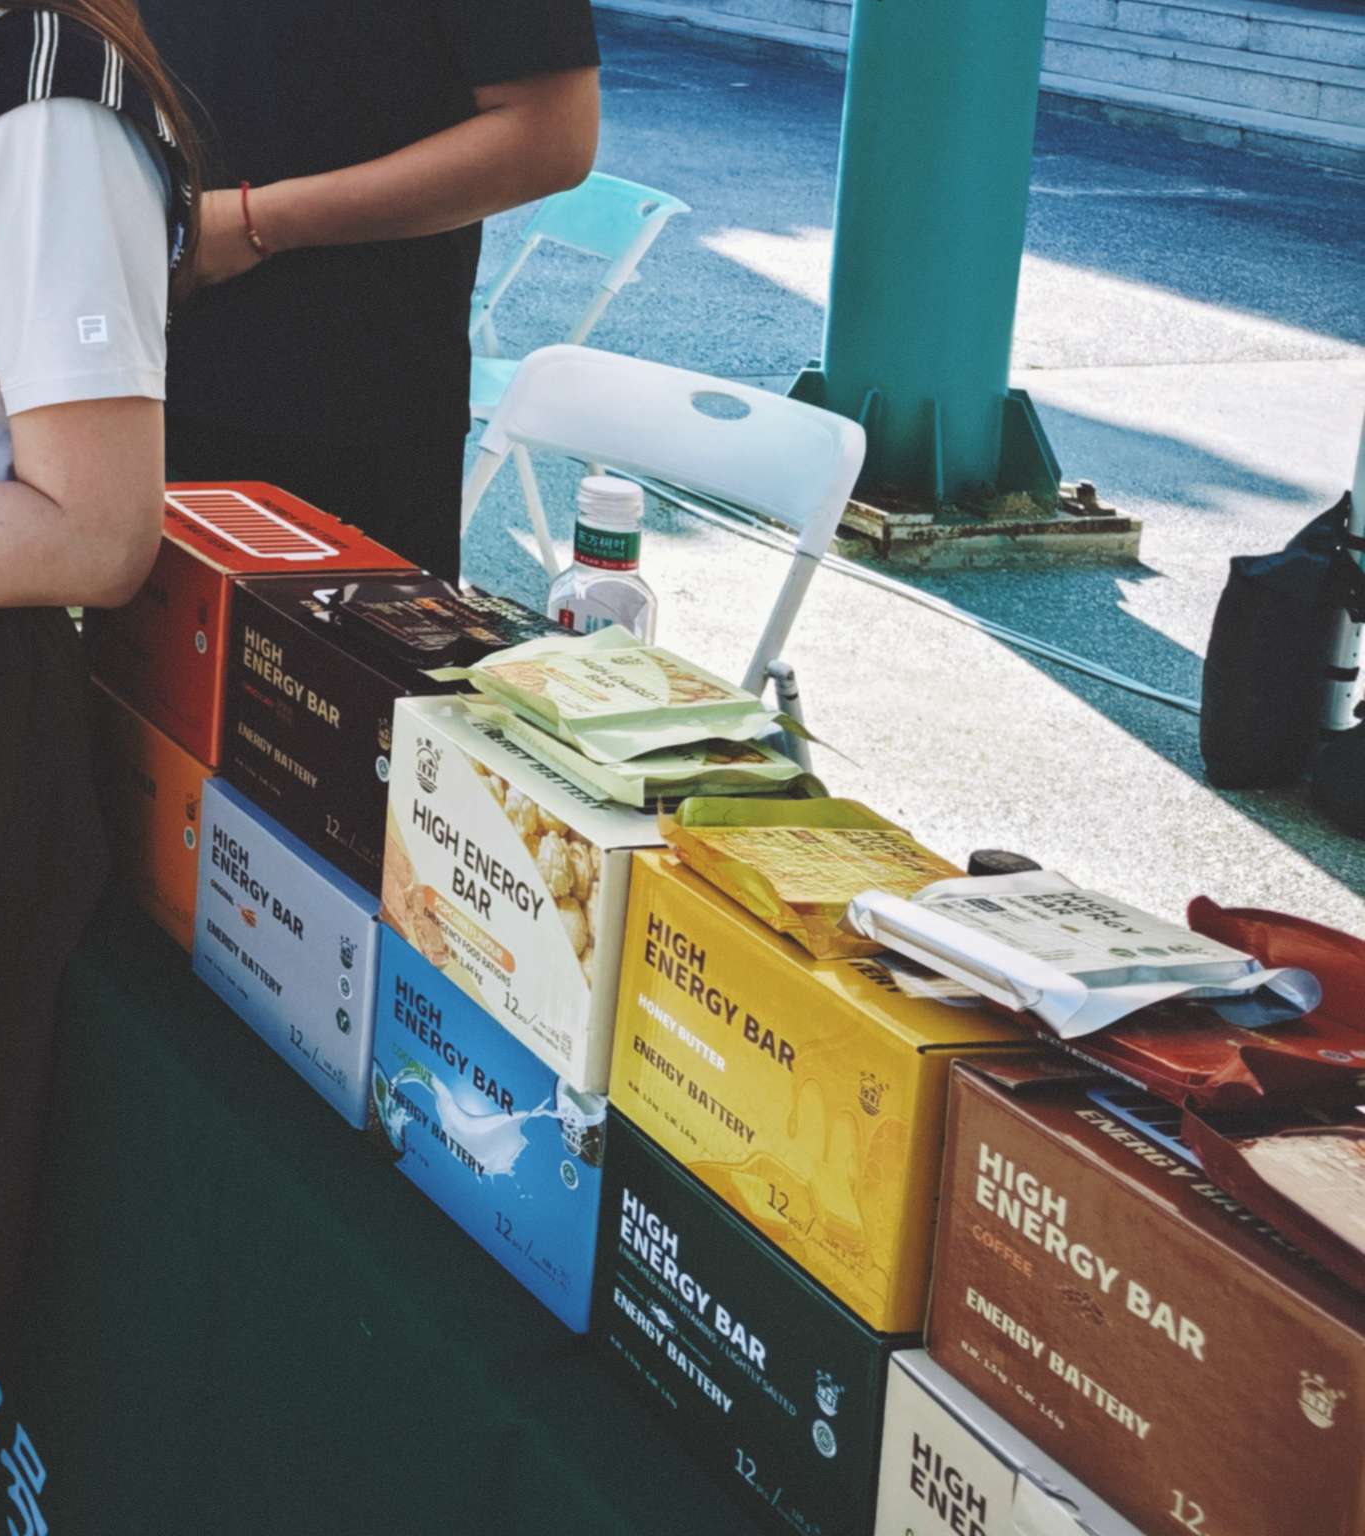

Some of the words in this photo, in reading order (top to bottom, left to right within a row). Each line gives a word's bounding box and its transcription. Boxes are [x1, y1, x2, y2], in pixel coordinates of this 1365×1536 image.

[244, 625, 284, 667] HIGH
[243, 647, 306, 703] ENERGY
[306, 689, 342, 730] BAR
[237, 720, 272, 756] ENERGY
[273, 747, 319, 789] BATTERY
[528, 762, 610, 812] BATTERY
[212, 823, 251, 871] HIGH
[324, 813, 341, 842] 12
[412, 798, 461, 857] HIGH
[462, 838, 545, 922] ENERGY
[210, 844, 271, 909] ENERGY
[272, 894, 305, 942] BAR
[451, 866, 493, 921] BAR
[1041, 893, 1142, 935] ENERGY
[1060, 891, 1128, 919] HIGH
[206, 917, 241, 959] ENERGY
[240, 948, 284, 999] BATTERY
[461, 941, 482, 965] FOOD
[646, 912, 707, 974] HIGH
[395, 975, 442, 1029] HIGH
[503, 991, 519, 1017] 12
[637, 992, 678, 1034] HONEY
[677, 1023, 727, 1073] BUTTER
[644, 941, 740, 1026] ENERGY
[743, 1012, 796, 1073] BAR
[288, 1022, 304, 1052] 12
[394, 999, 469, 1076] ENERGY
[471, 1065, 515, 1117] BAR
[633, 1034, 687, 1089] ENERGY
[687, 1078, 757, 1145] BATTERY
[387, 1083, 429, 1129] ENERGY
[430, 1119, 486, 1177] BATTERY
[1075, 1109, 1198, 1179] ENERGY
[767, 1183, 790, 1219] 12
[978, 1142, 1068, 1227] HIGH
[493, 1210, 515, 1244] 12
[621, 1188, 680, 1260] HIGH
[971, 1225, 1033, 1279] COFFEE
[619, 1218, 712, 1315] ENERGY
[715, 1302, 768, 1372] BAR
[975, 1174, 1120, 1295] ENERGY
[1126, 1279, 1207, 1362] BAR
[613, 1286, 666, 1348] ENERGY
[665, 1341, 734, 1415] BATTERY
[965, 1286, 1046, 1360] ENERGY
[1049, 1349, 1151, 1441] BATTERY
[734, 1446, 757, 1488] 12
[912, 1431, 987, 1525] HIGH
[1168, 1488, 1207, 1536] 12
